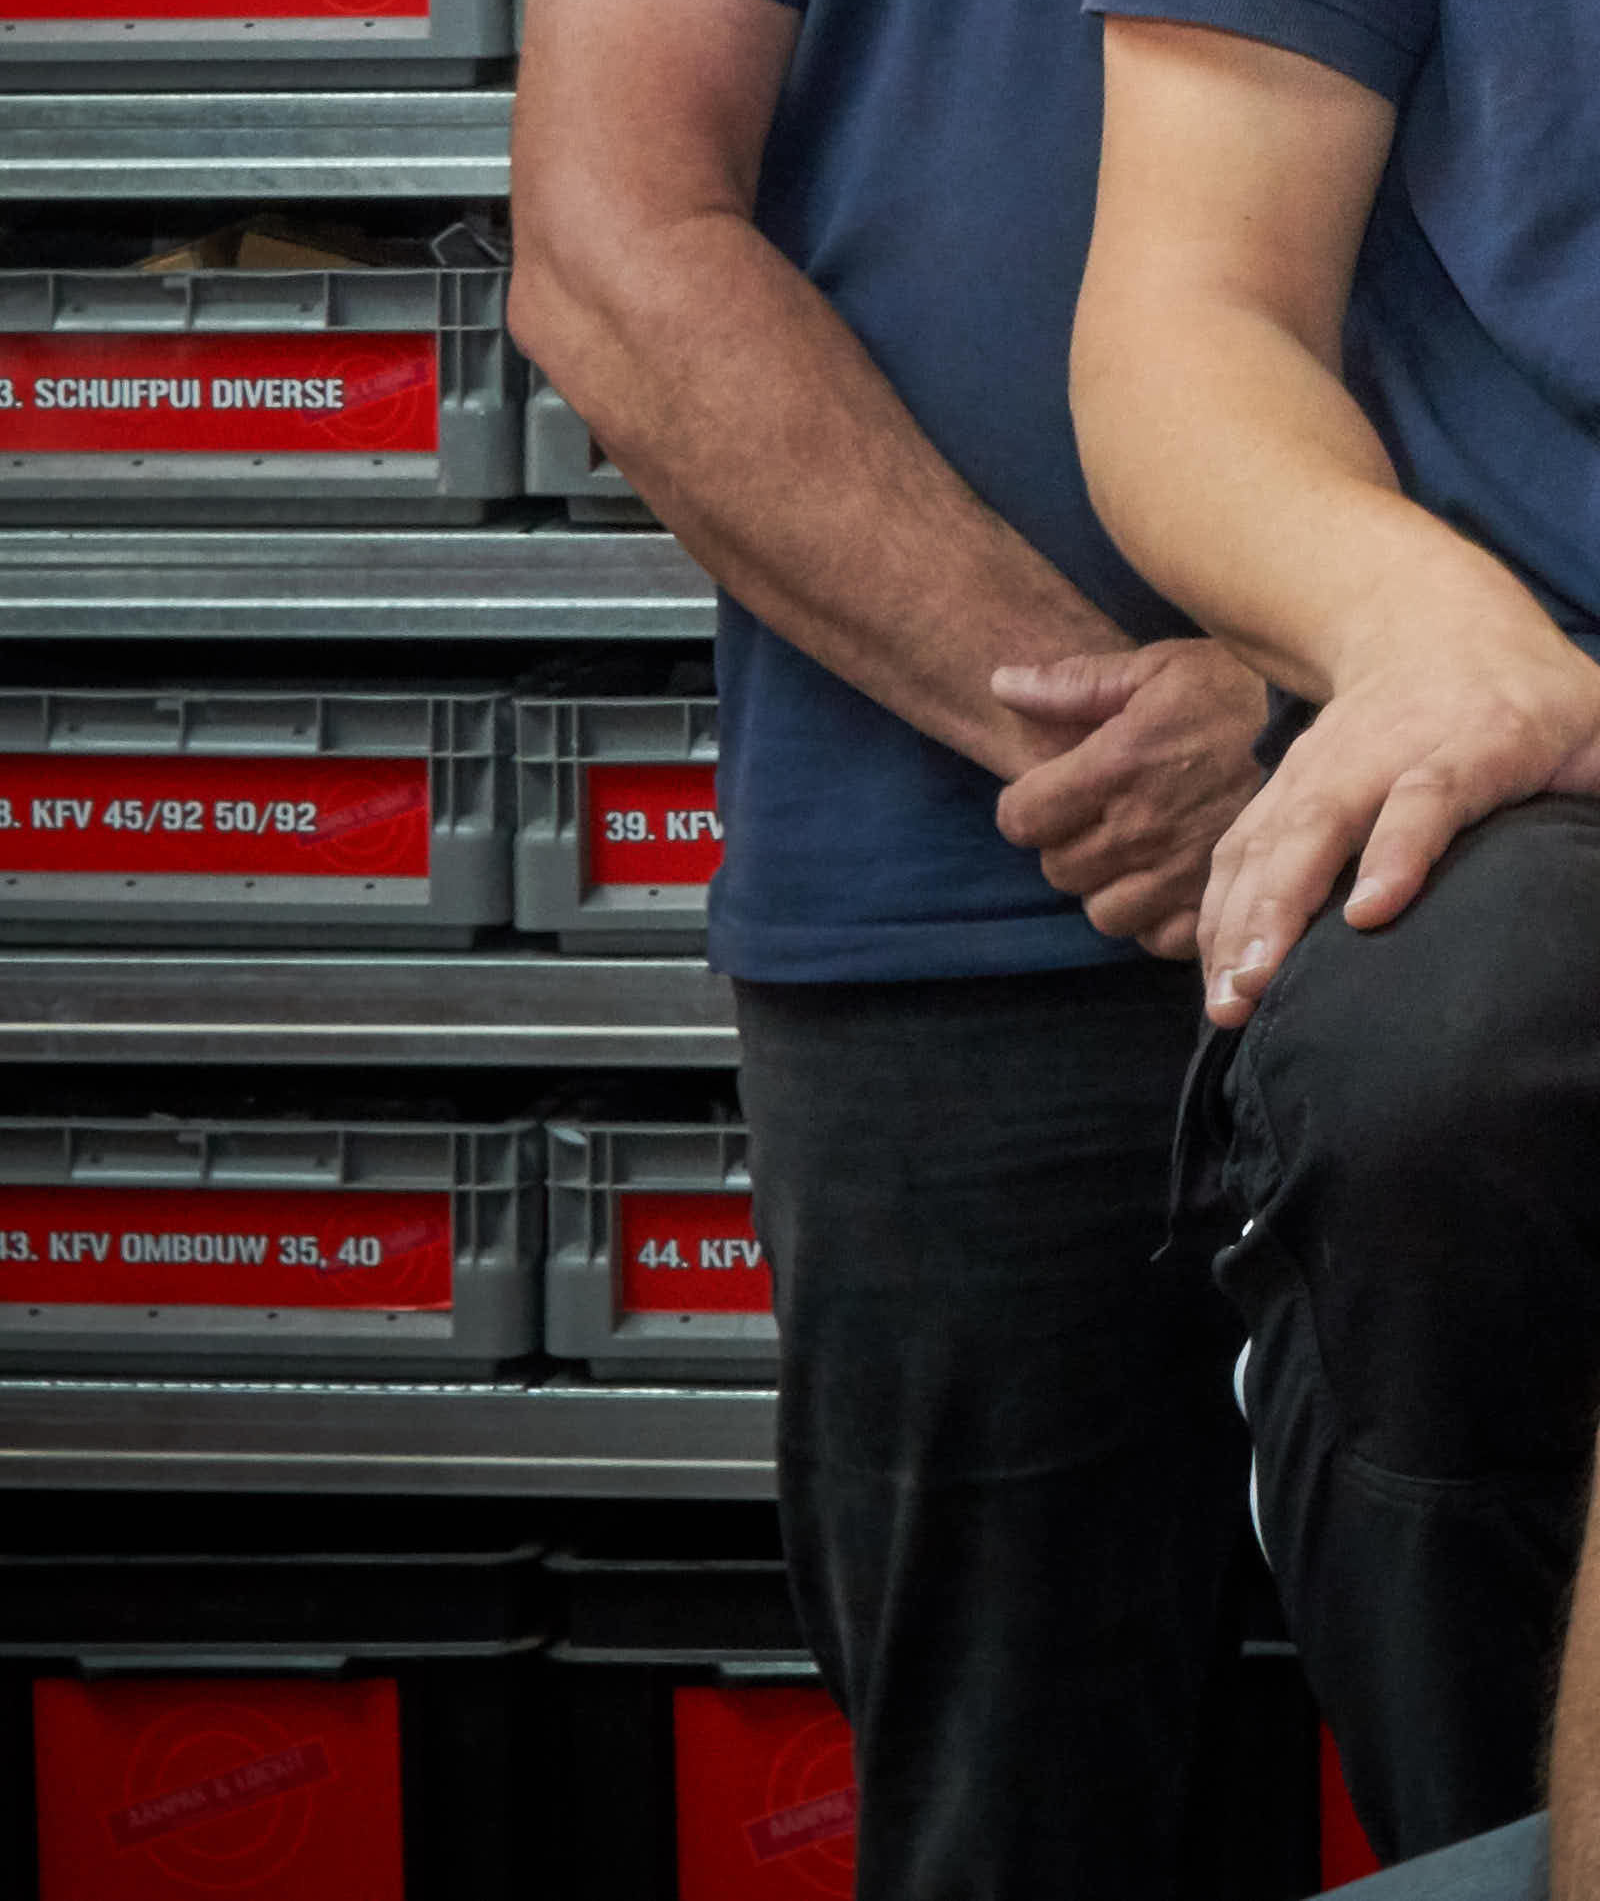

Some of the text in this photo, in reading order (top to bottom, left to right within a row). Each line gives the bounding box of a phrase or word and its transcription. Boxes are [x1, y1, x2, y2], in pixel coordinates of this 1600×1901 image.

[33, 377, 202, 410] SCHUIFPUI
[210, 377, 345, 410] DIVERSE
[30, 798, 94, 830] KFV
[101, 799, 205, 834] 45/92
[213, 800, 319, 835] 50/92
[604, 809, 657, 843] 39.
[48, 1231, 112, 1263] KFV
[119, 1232, 270, 1266] OMBOUW
[277, 1234, 329, 1270] 35,
[335, 1235, 383, 1268] 40
[637, 1237, 764, 1270] 44. KFV
